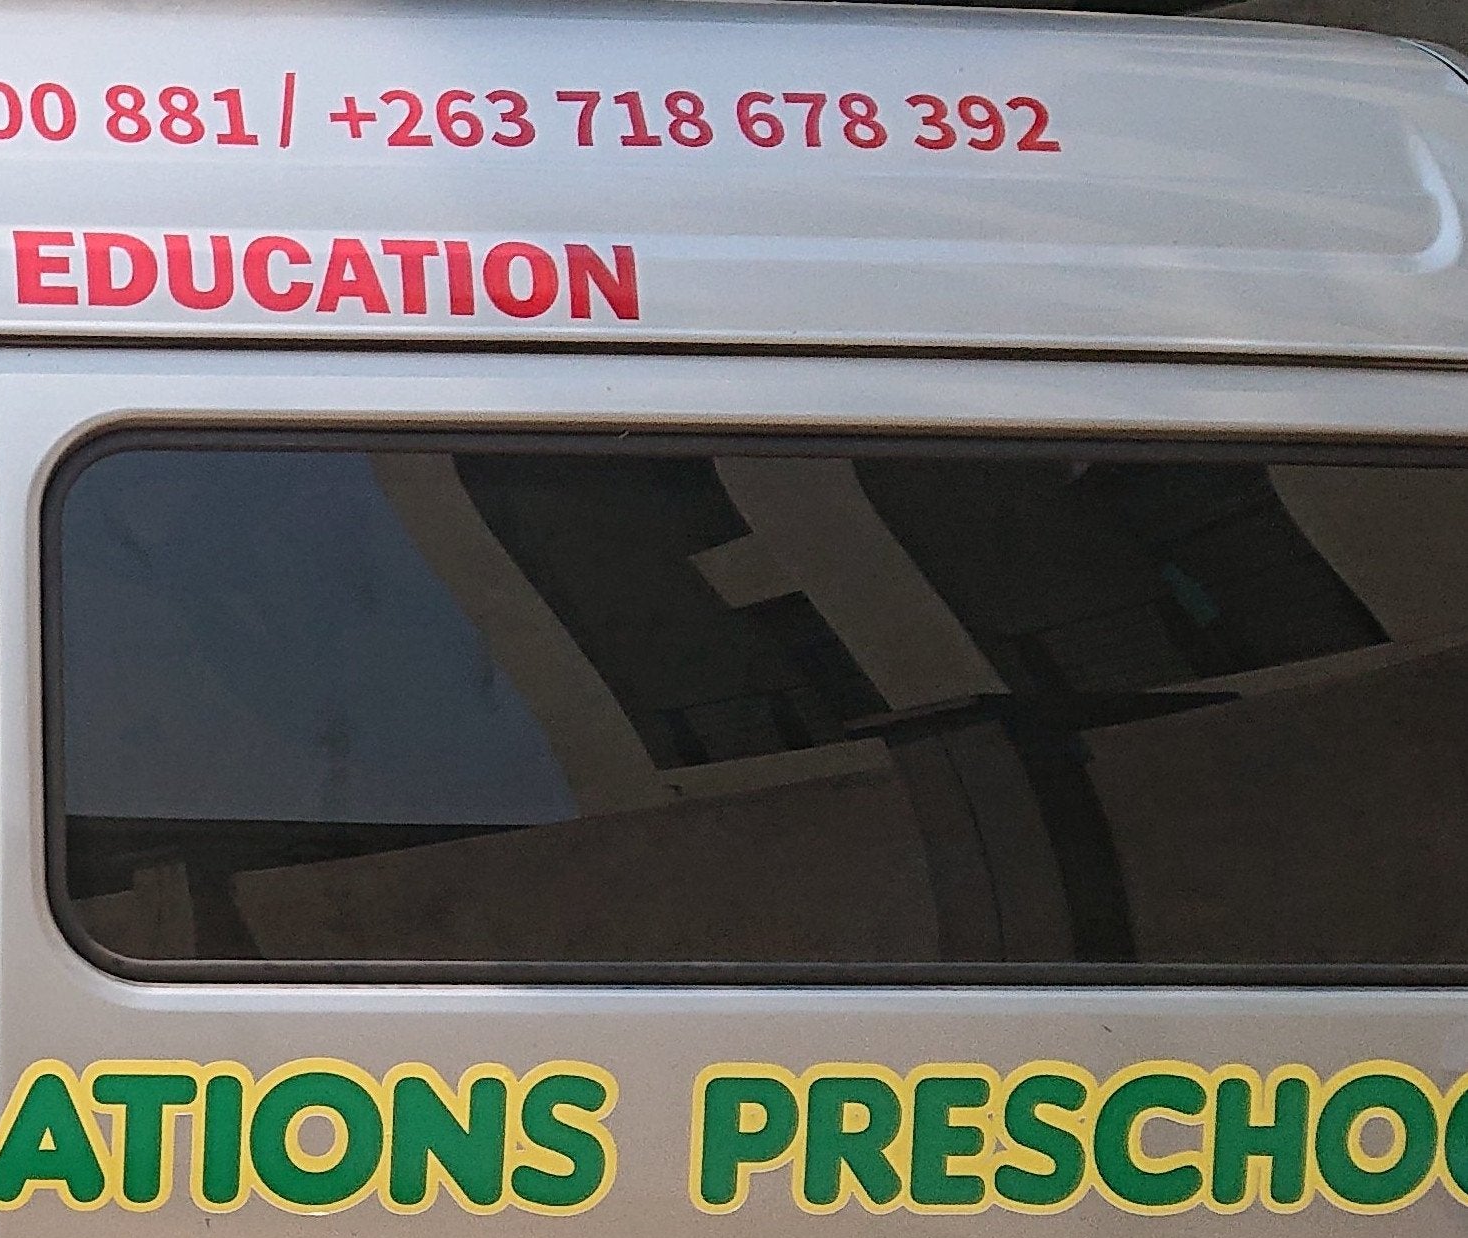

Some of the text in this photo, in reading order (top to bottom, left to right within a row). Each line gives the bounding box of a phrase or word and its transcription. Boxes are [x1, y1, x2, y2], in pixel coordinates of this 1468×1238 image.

[329, 89, 537, 149] +263
[555, 91, 714, 149] 718
[736, 91, 888, 150] 678
[906, 93, 1061, 153] 392
[13, 230, 640, 321] EDUCATION
[689, 1060, 1468, 1213] PRESCHO
